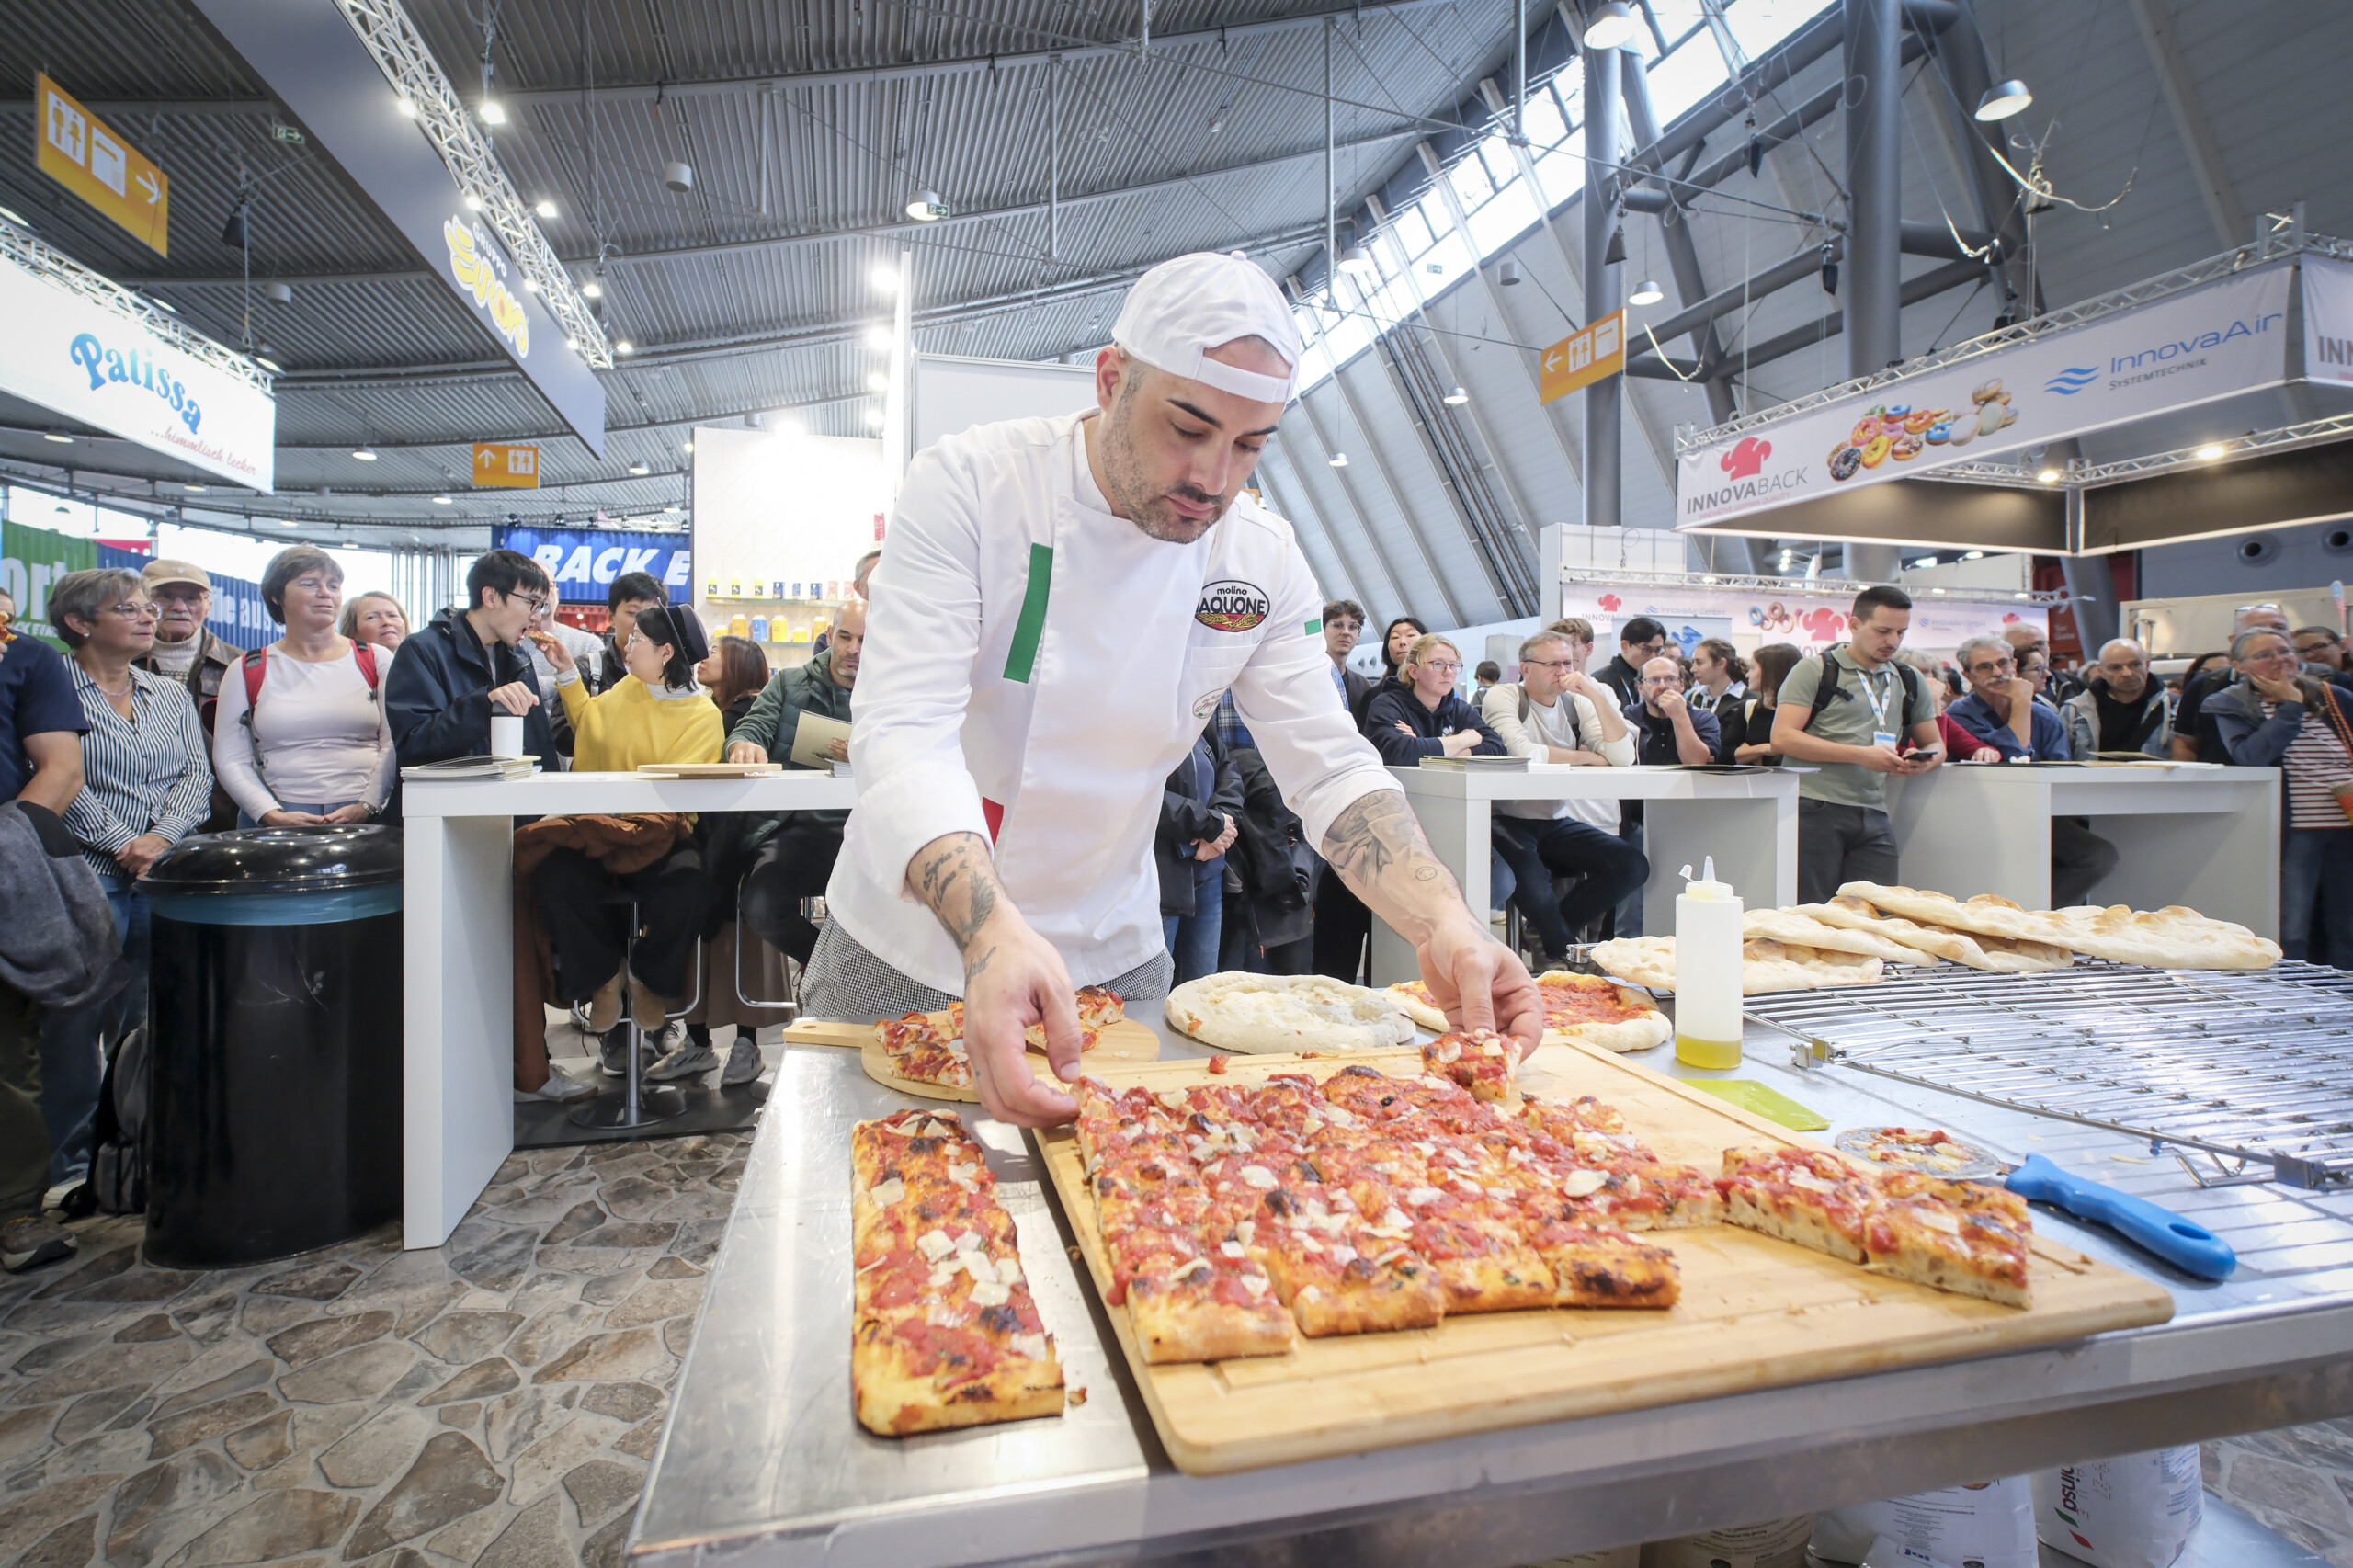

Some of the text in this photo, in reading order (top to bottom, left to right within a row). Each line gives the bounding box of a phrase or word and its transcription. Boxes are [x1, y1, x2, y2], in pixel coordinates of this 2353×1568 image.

[472, 222, 506, 277] GRUPPO
[2109, 312, 2283, 374] InnovaAir
[70, 333, 201, 435] Patissa
[226, 451, 256, 476] lecker
[1686, 465, 1809, 515] INNOVABACK
[1762, 491, 1791, 505] QUALITY
[534, 544, 660, 584] BACK
[1216, 585, 1248, 596] molino
[1700, 608, 1725, 616] GmbH
